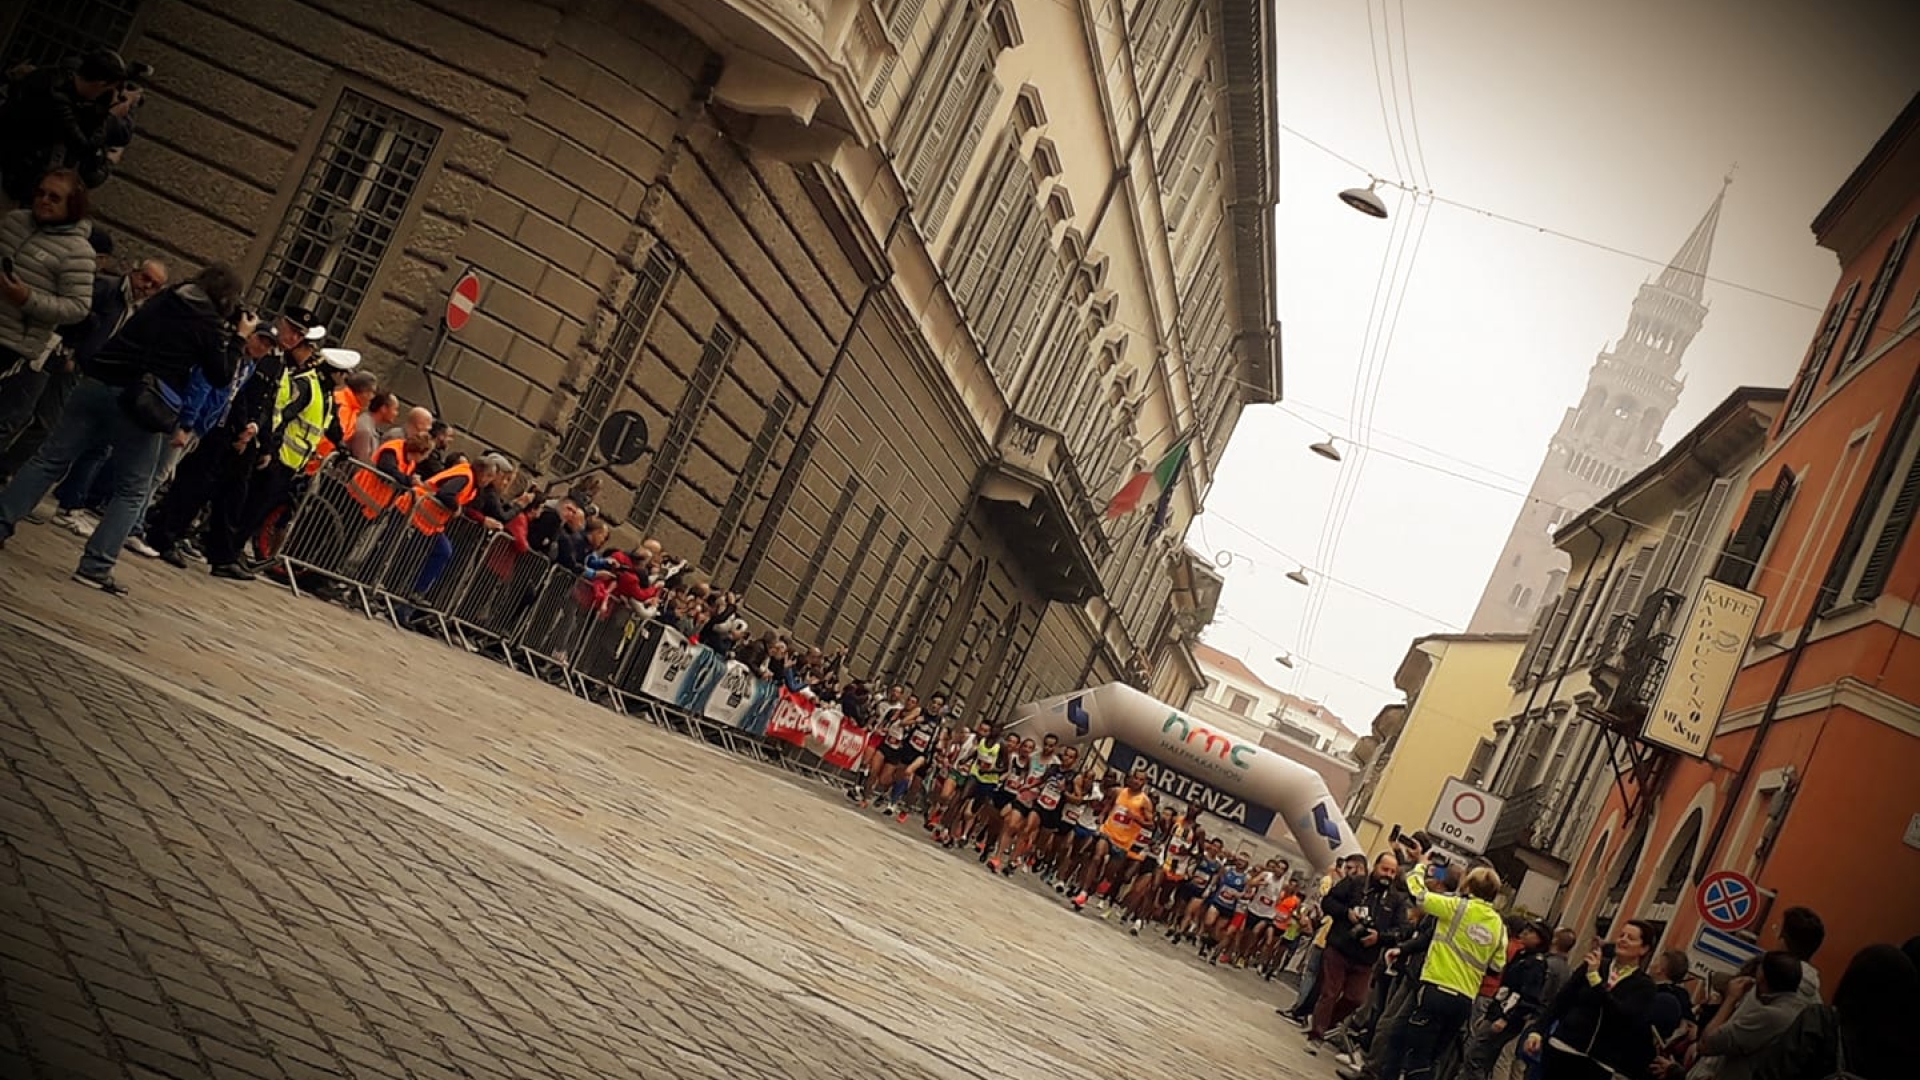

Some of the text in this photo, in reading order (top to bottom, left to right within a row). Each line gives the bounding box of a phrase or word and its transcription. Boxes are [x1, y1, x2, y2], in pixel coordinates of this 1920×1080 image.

[1131, 755, 1247, 824] PARTENZA
[1440, 822, 1475, 845] 100 m
